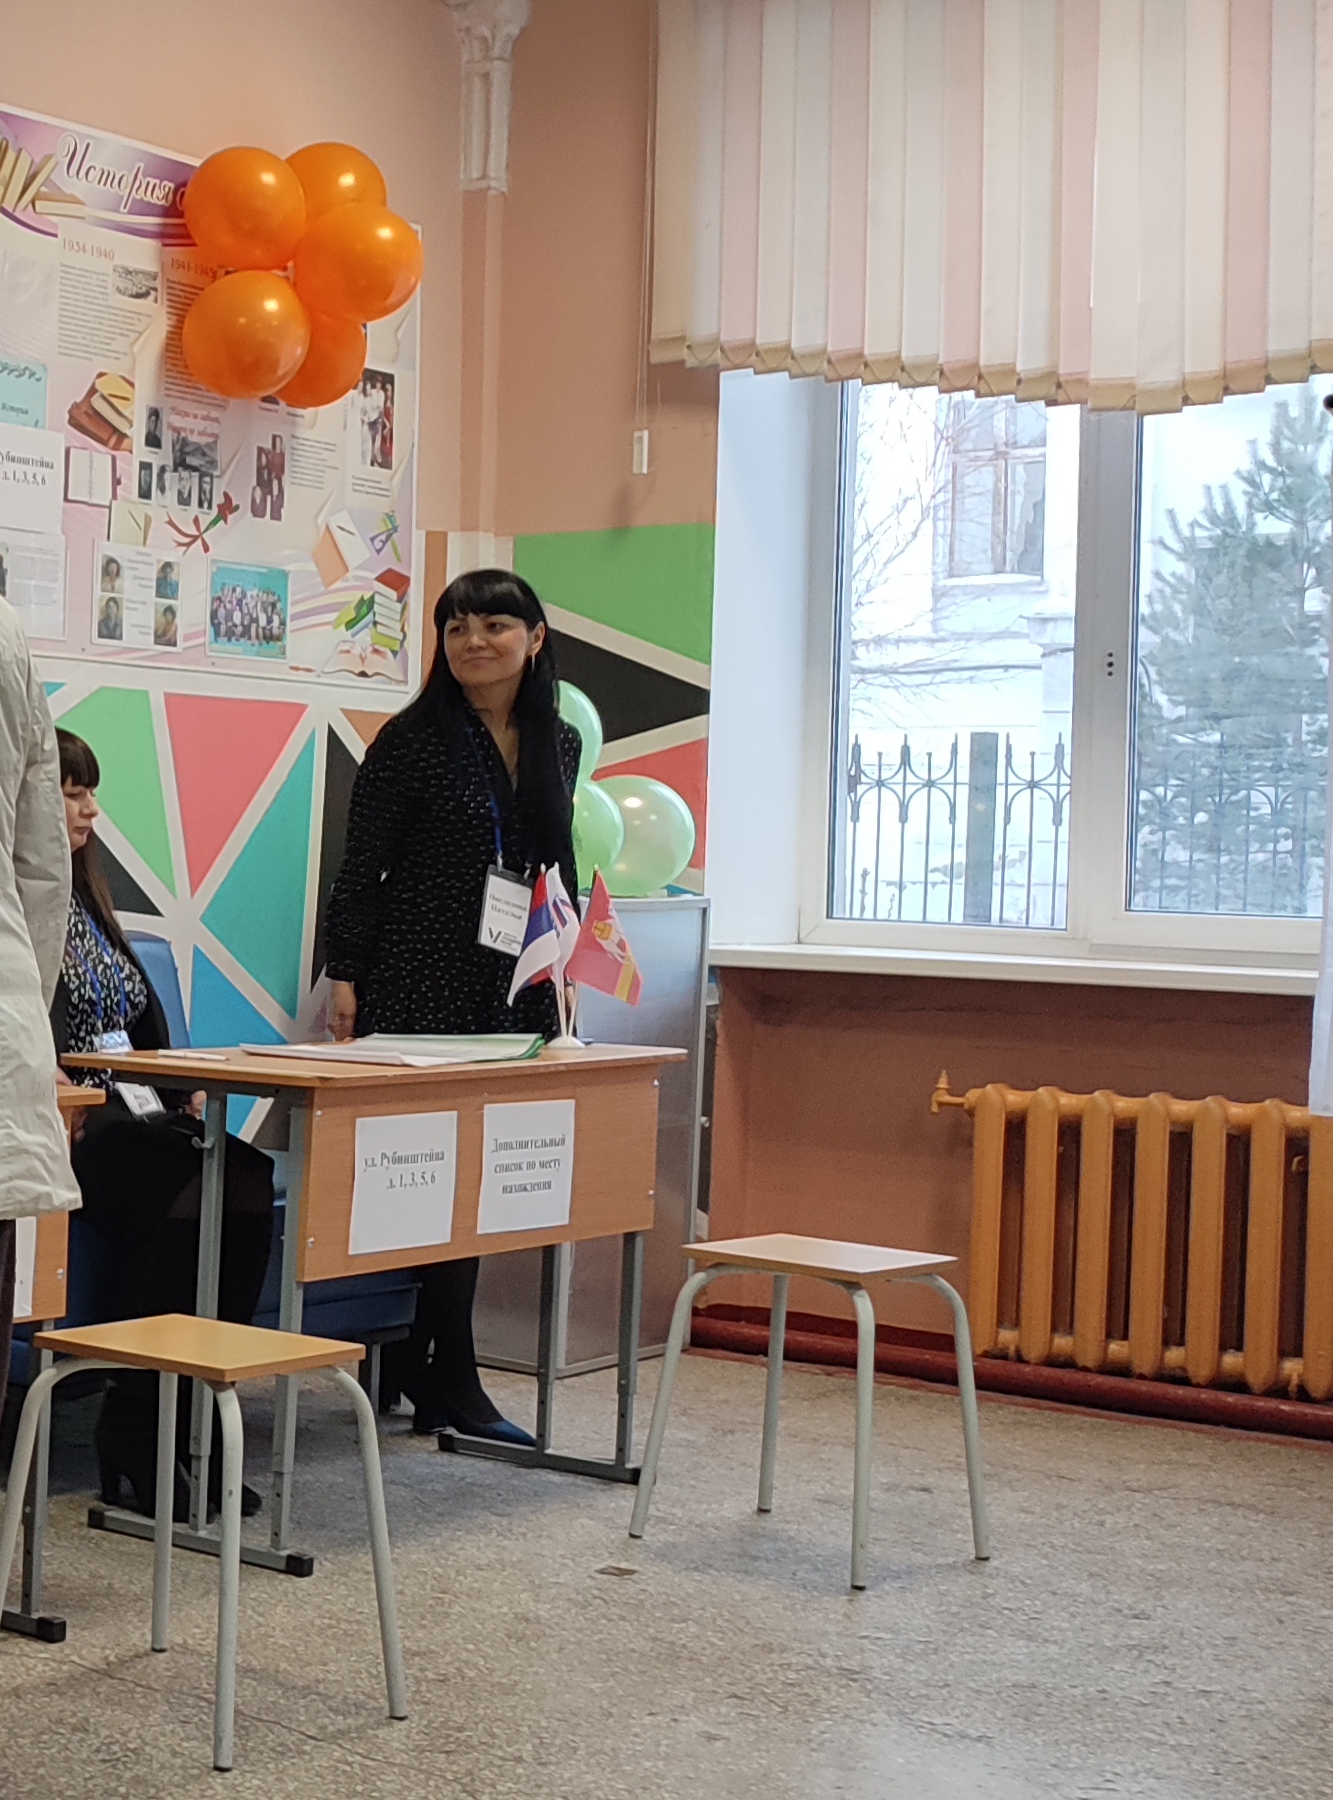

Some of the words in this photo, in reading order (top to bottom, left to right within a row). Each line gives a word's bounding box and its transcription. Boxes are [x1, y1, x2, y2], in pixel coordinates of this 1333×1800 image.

[60, 134, 174, 211] История
[491, 1133, 566, 1154] Дополнительный
[380, 1149, 445, 1170] Рубинштейна
[494, 1160, 524, 1175] список
[526, 1159, 536, 1172] по
[539, 1157, 562, 1173] месту
[501, 1179, 552, 1196] нахождения
